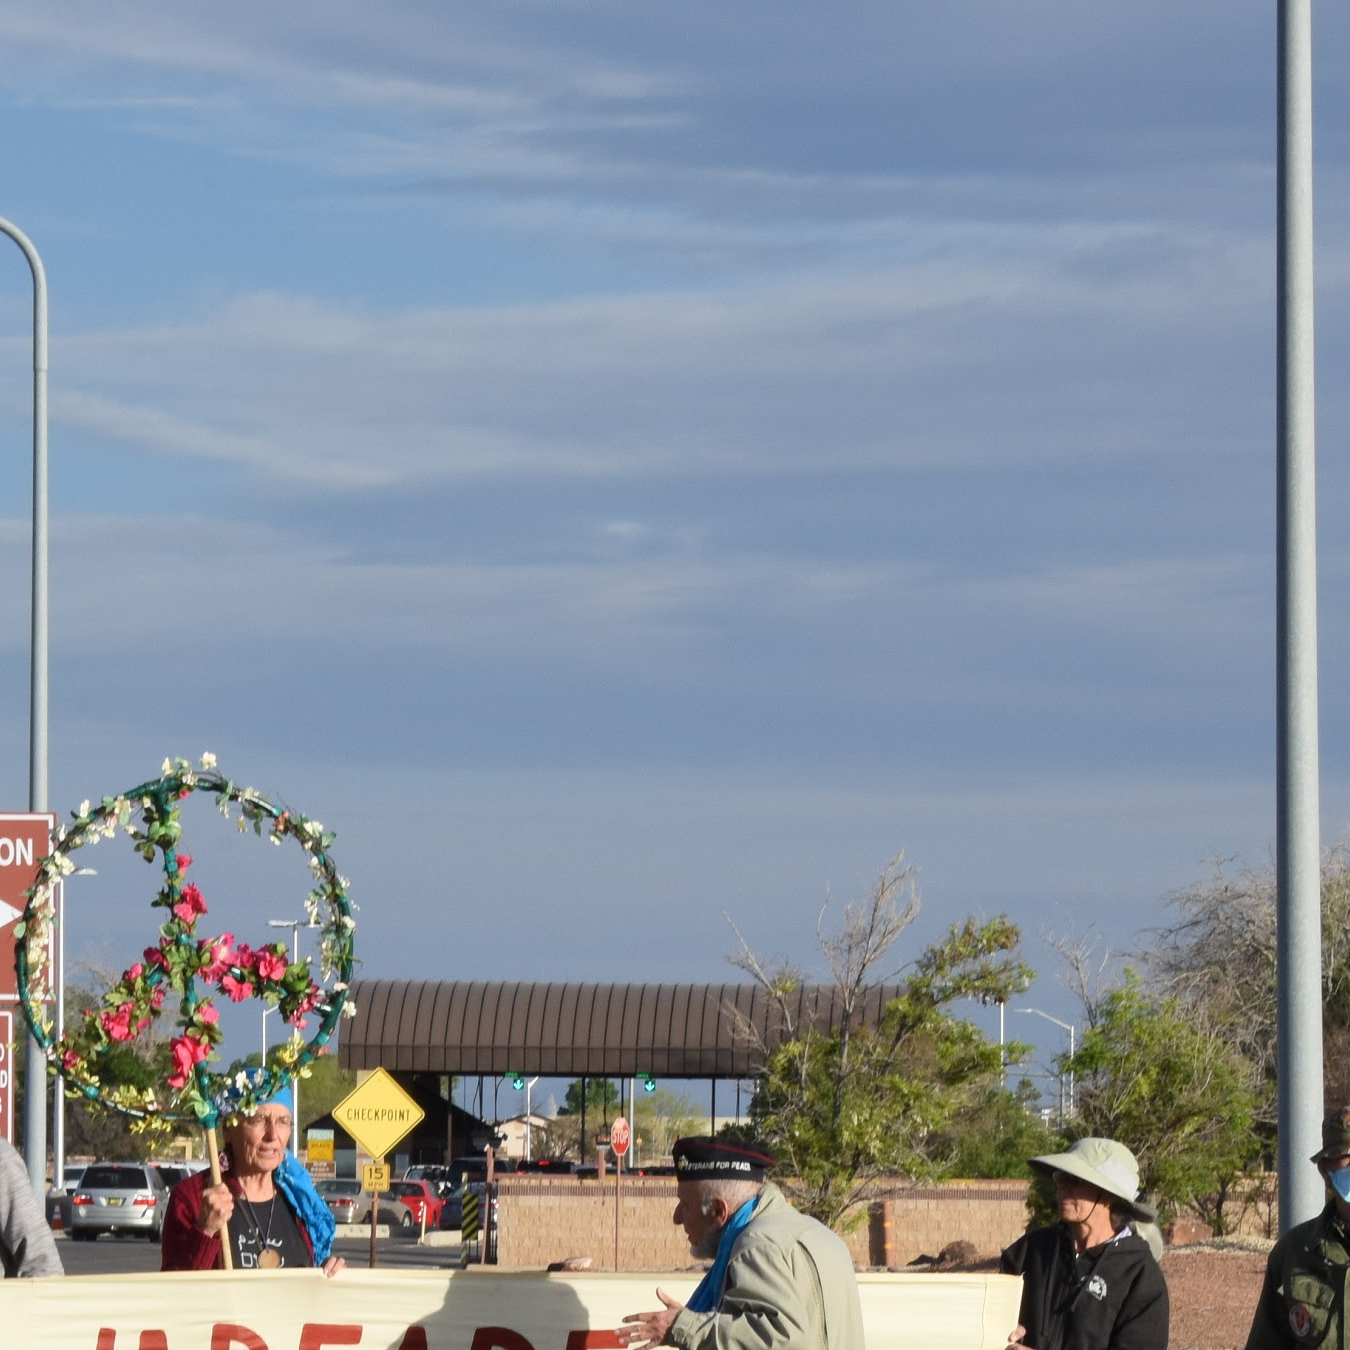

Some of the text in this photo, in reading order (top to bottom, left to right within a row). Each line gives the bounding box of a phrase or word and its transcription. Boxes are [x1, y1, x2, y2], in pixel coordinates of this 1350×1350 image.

[347, 1108, 411, 1122] CHECKPOINT
[613, 1130, 629, 1144] STOP
[716, 1161, 730, 1170] FOR
[368, 1168, 384, 1180] 15
